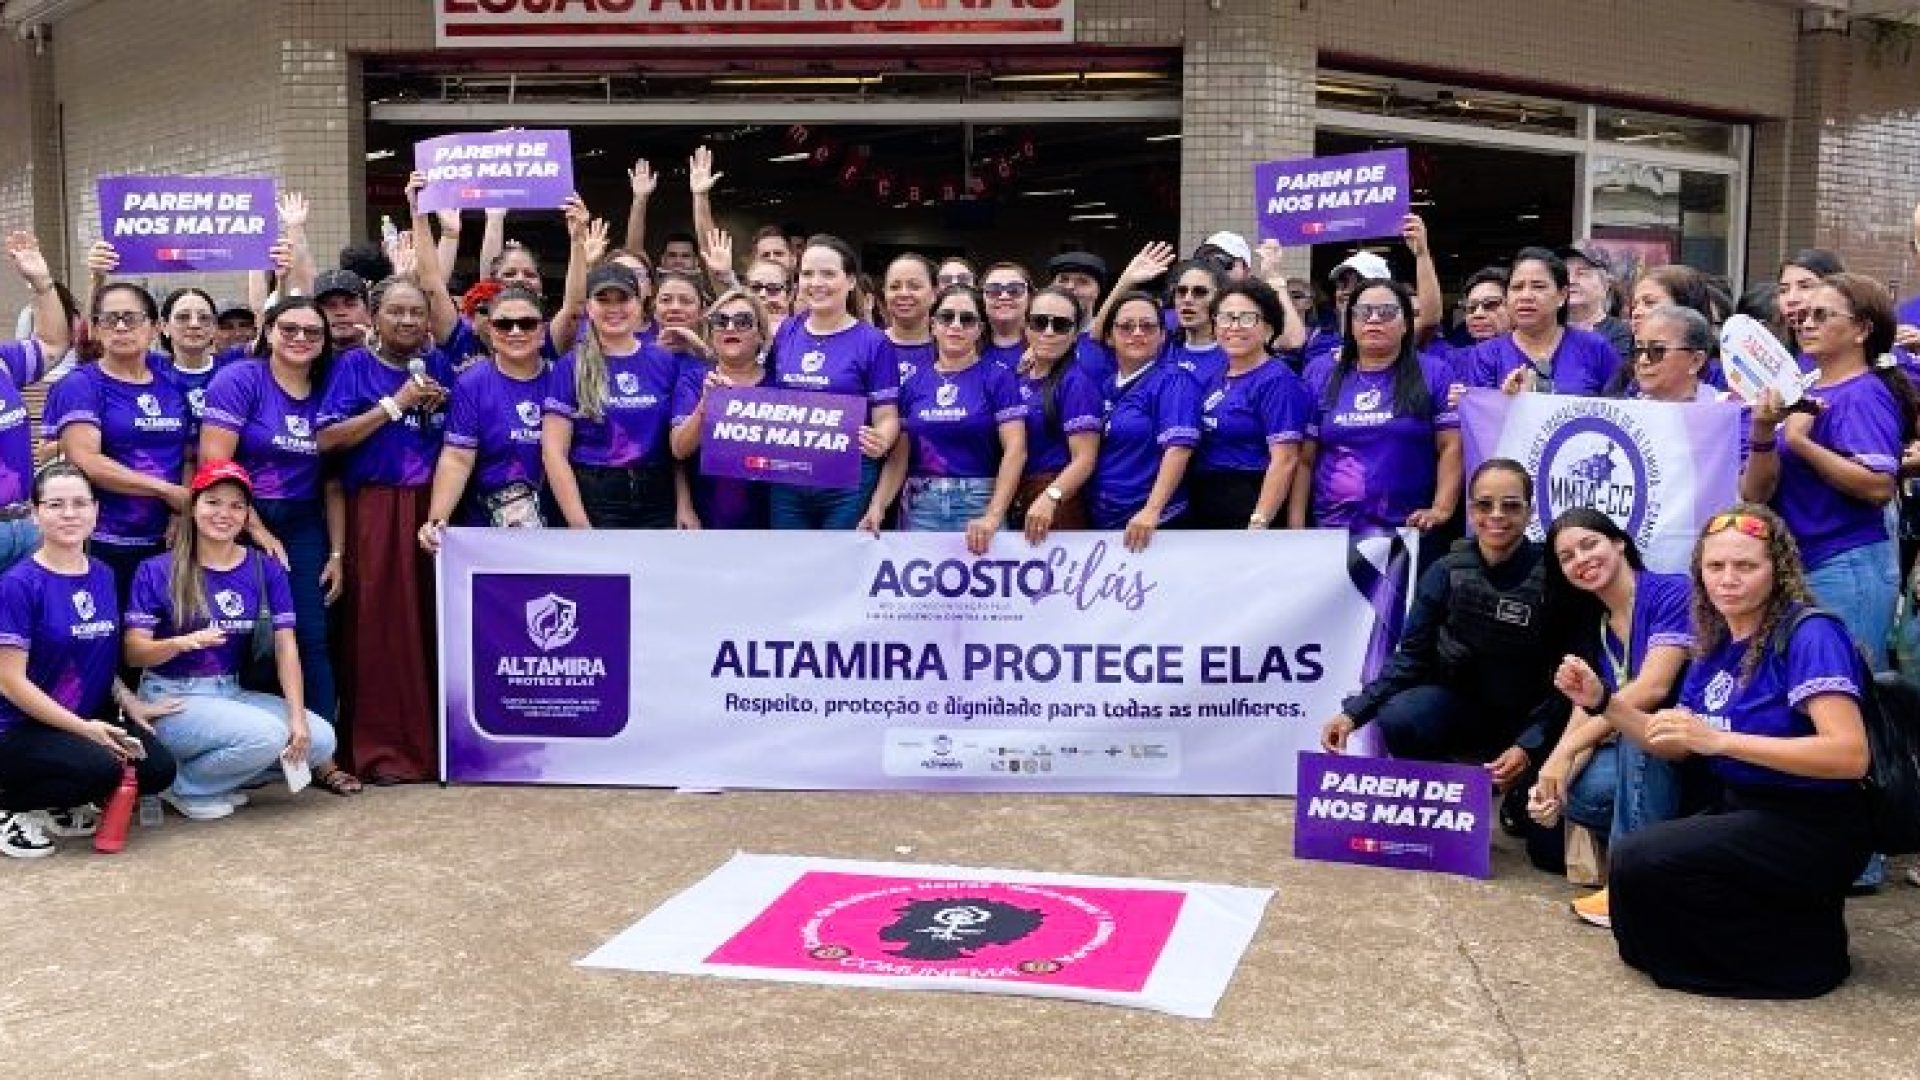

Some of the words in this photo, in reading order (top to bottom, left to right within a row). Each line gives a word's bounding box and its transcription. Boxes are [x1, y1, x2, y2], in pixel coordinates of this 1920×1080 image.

[435, 143, 515, 162] PAREM
[517, 142, 548, 157] DE
[427, 164, 473, 182] NOS
[477, 161, 560, 177] MATAR
[1276, 168, 1352, 192] PAREM
[1356, 165, 1386, 183] DE
[123, 192, 214, 211] PAREM
[217, 192, 252, 211] DE
[1268, 194, 1314, 214] NOS
[1317, 186, 1397, 209] MATAR
[113, 217, 169, 236] NOS
[174, 216, 265, 235] MATAR
[726, 399, 807, 423] PAREM
[809, 407, 844, 427] DE
[712, 422, 763, 442] NOS
[765, 428, 850, 452] MATAR
[868, 558, 1053, 598] AGOSTO
[496, 656, 607, 676] ALTAMIRA
[710, 641, 948, 681] ALTAMIRA
[963, 643, 1184, 684] PROTEGE
[1200, 643, 1324, 684] ELAS
[725, 693, 818, 715] Respeito,
[824, 695, 921, 719] proteção
[926, 700, 939, 714] e
[944, 695, 1041, 721] dignidade
[1048, 702, 1096, 722] para
[1104, 698, 1163, 719] todas
[1169, 704, 1192, 718] as
[1199, 697, 1306, 718] mulheres.
[1320, 771, 1420, 799] PAREM
[1424, 781, 1464, 803] DE
[1307, 796, 1368, 821] NOS
[1372, 804, 1475, 832] MATAR
[840, 957, 1020, 977] COMUNEMA
